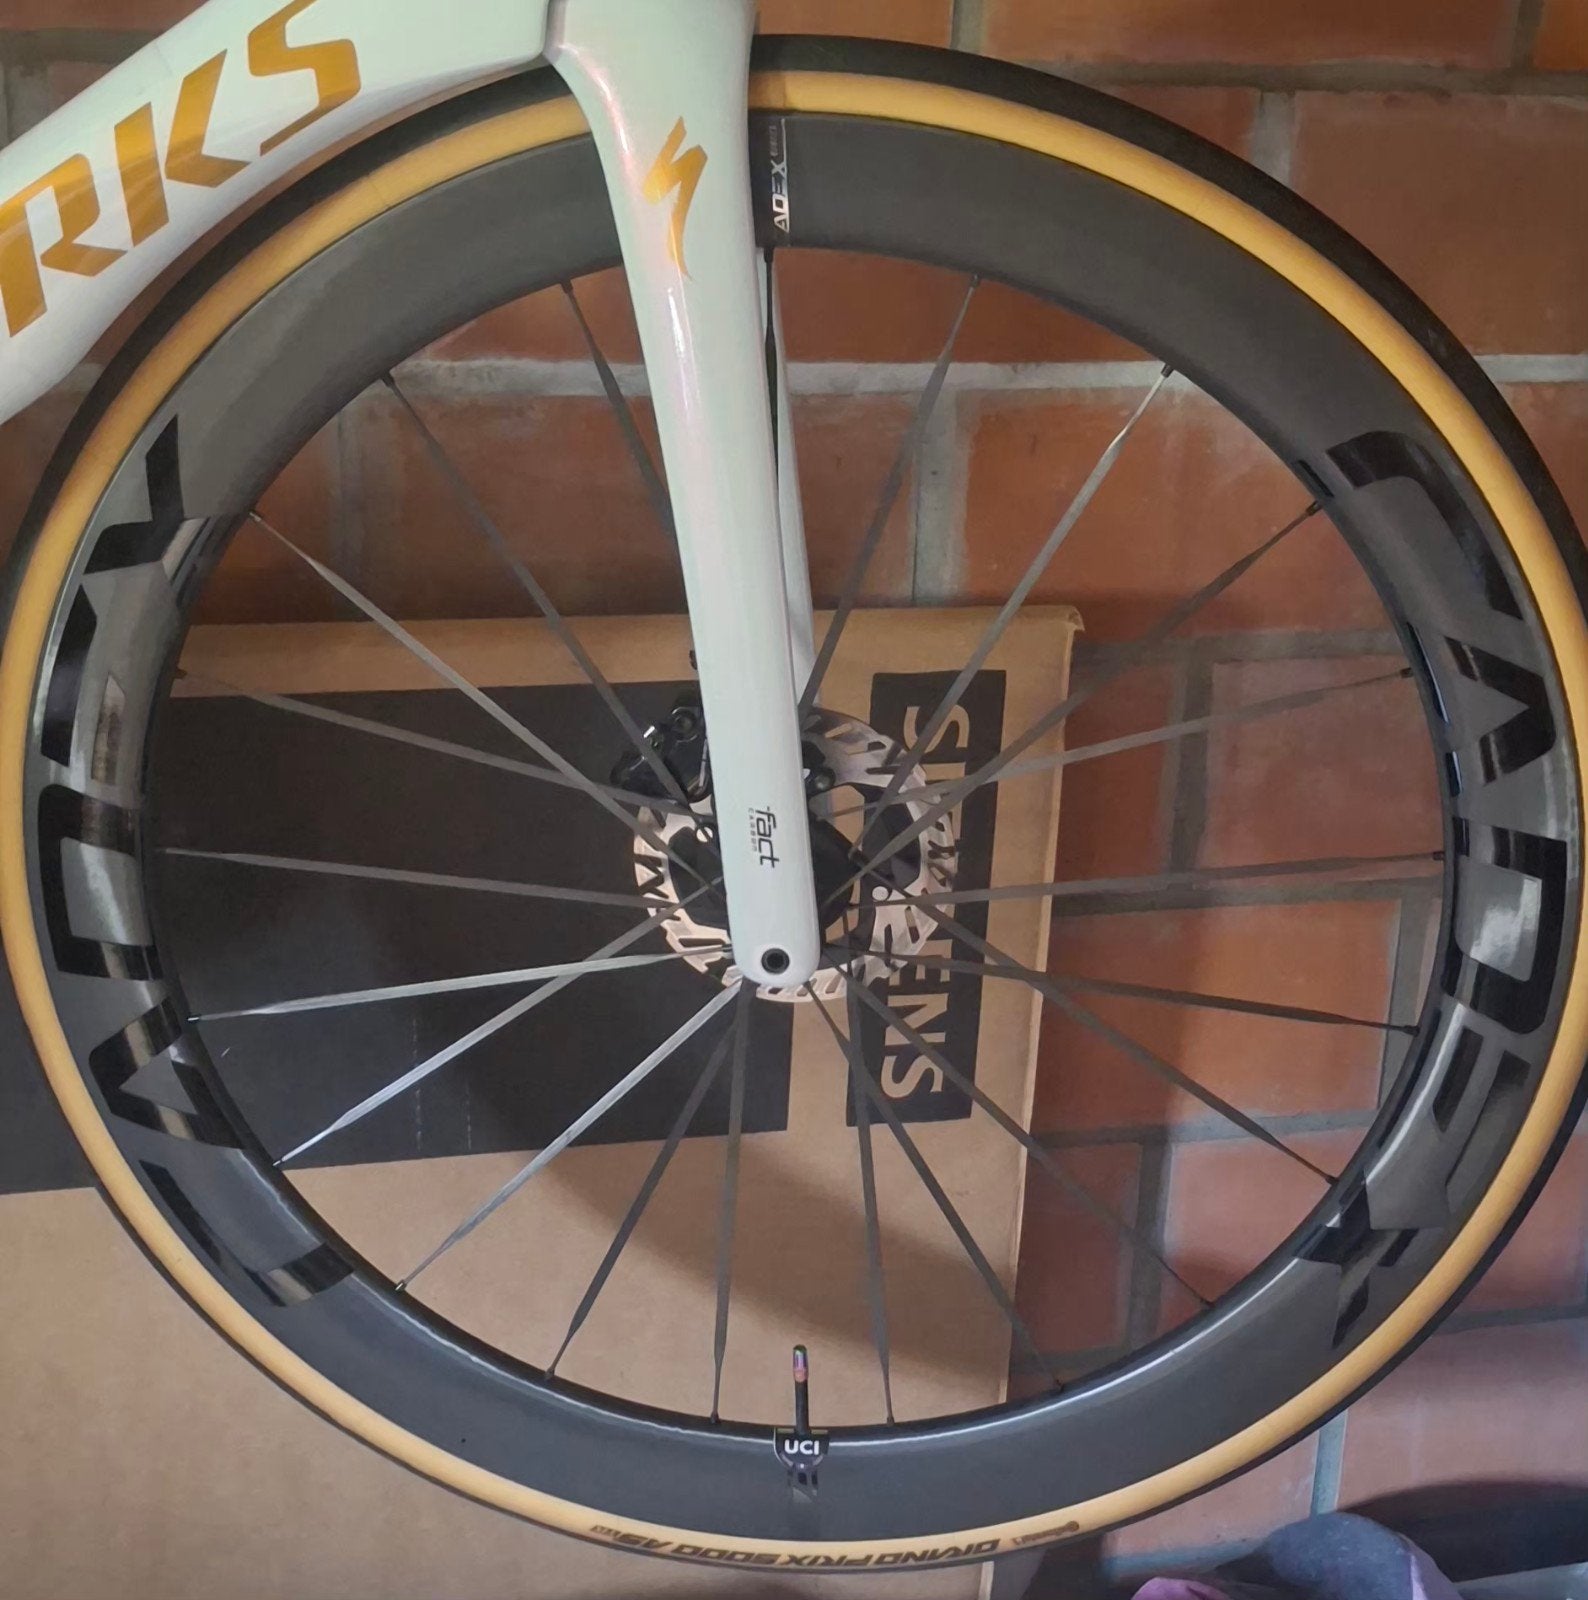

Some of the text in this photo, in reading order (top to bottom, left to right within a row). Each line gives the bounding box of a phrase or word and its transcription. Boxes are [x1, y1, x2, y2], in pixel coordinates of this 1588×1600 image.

[755, 806, 780, 868] fact
[1294, 430, 1567, 1349] CADEX
[784, 1439, 820, 1455] UCI
[671, 1544, 781, 1565] 5000
[785, 1552, 875, 1567] PRIX
[874, 1538, 1001, 1566] GRAND
